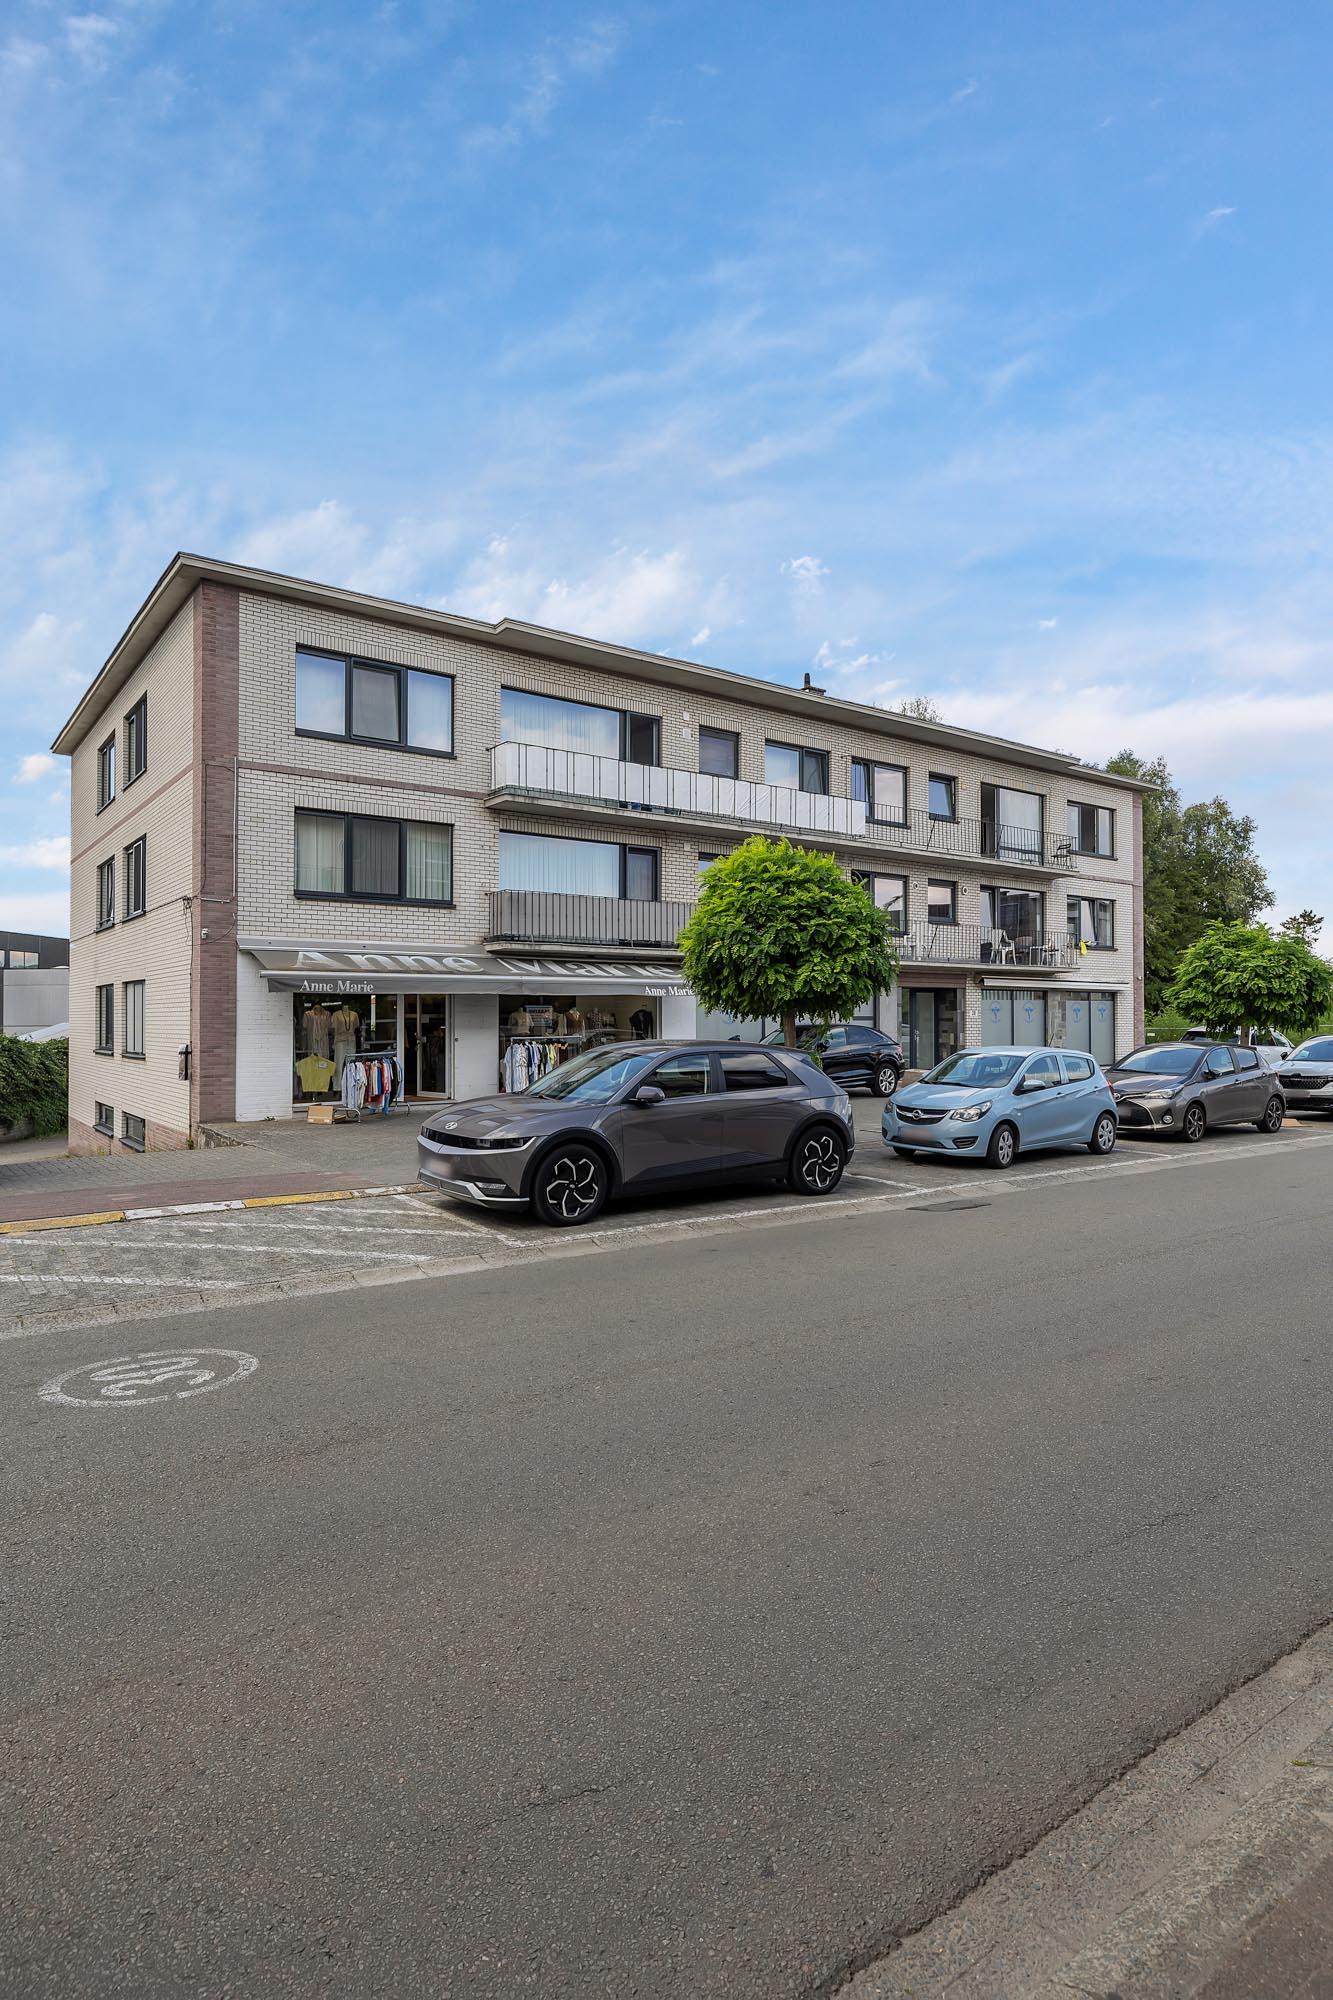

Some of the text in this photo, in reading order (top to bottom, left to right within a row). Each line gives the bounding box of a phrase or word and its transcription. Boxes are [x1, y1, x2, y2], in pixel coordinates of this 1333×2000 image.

[292, 951, 683, 978] Anne Marie
[299, 980, 374, 993] Anne Marie
[645, 986, 695, 996] Anne Marie
